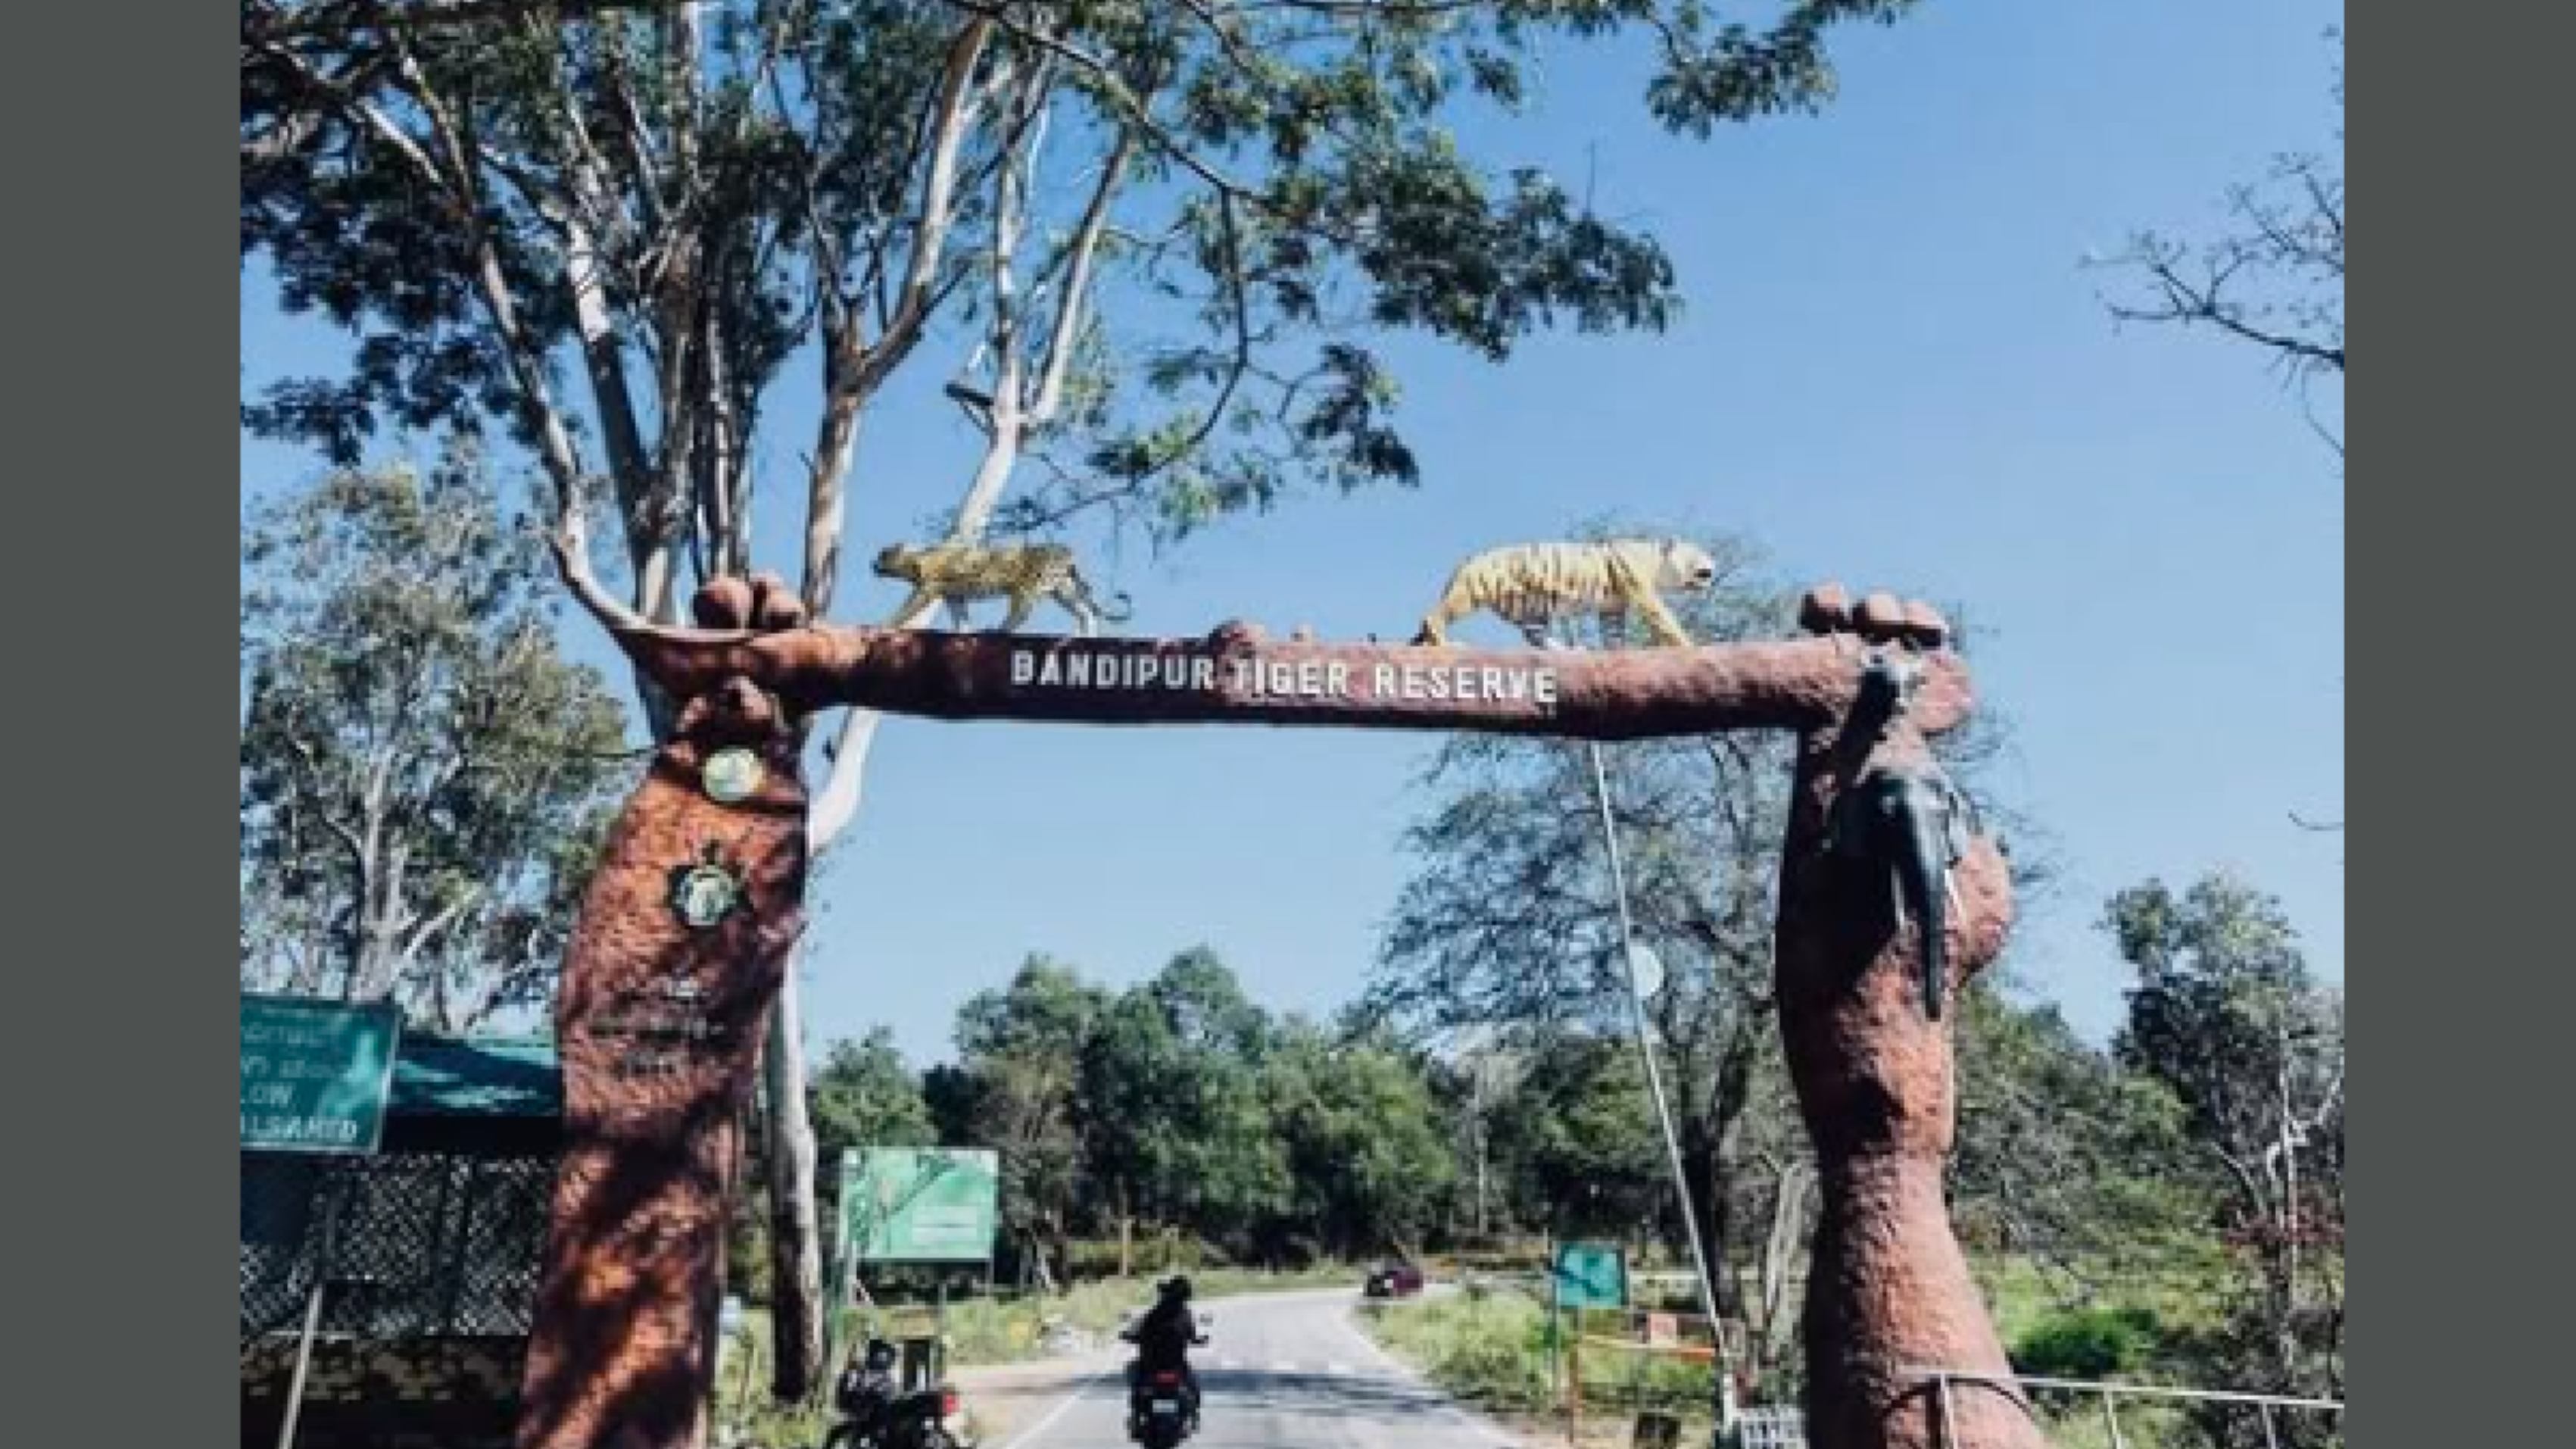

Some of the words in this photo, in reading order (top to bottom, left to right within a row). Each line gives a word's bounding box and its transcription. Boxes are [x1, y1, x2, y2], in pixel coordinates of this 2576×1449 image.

[1012, 650, 1215, 690] BANDIPUR
[1231, 656, 1348, 695] TIGER
[1374, 662, 1558, 703] RESERVE
